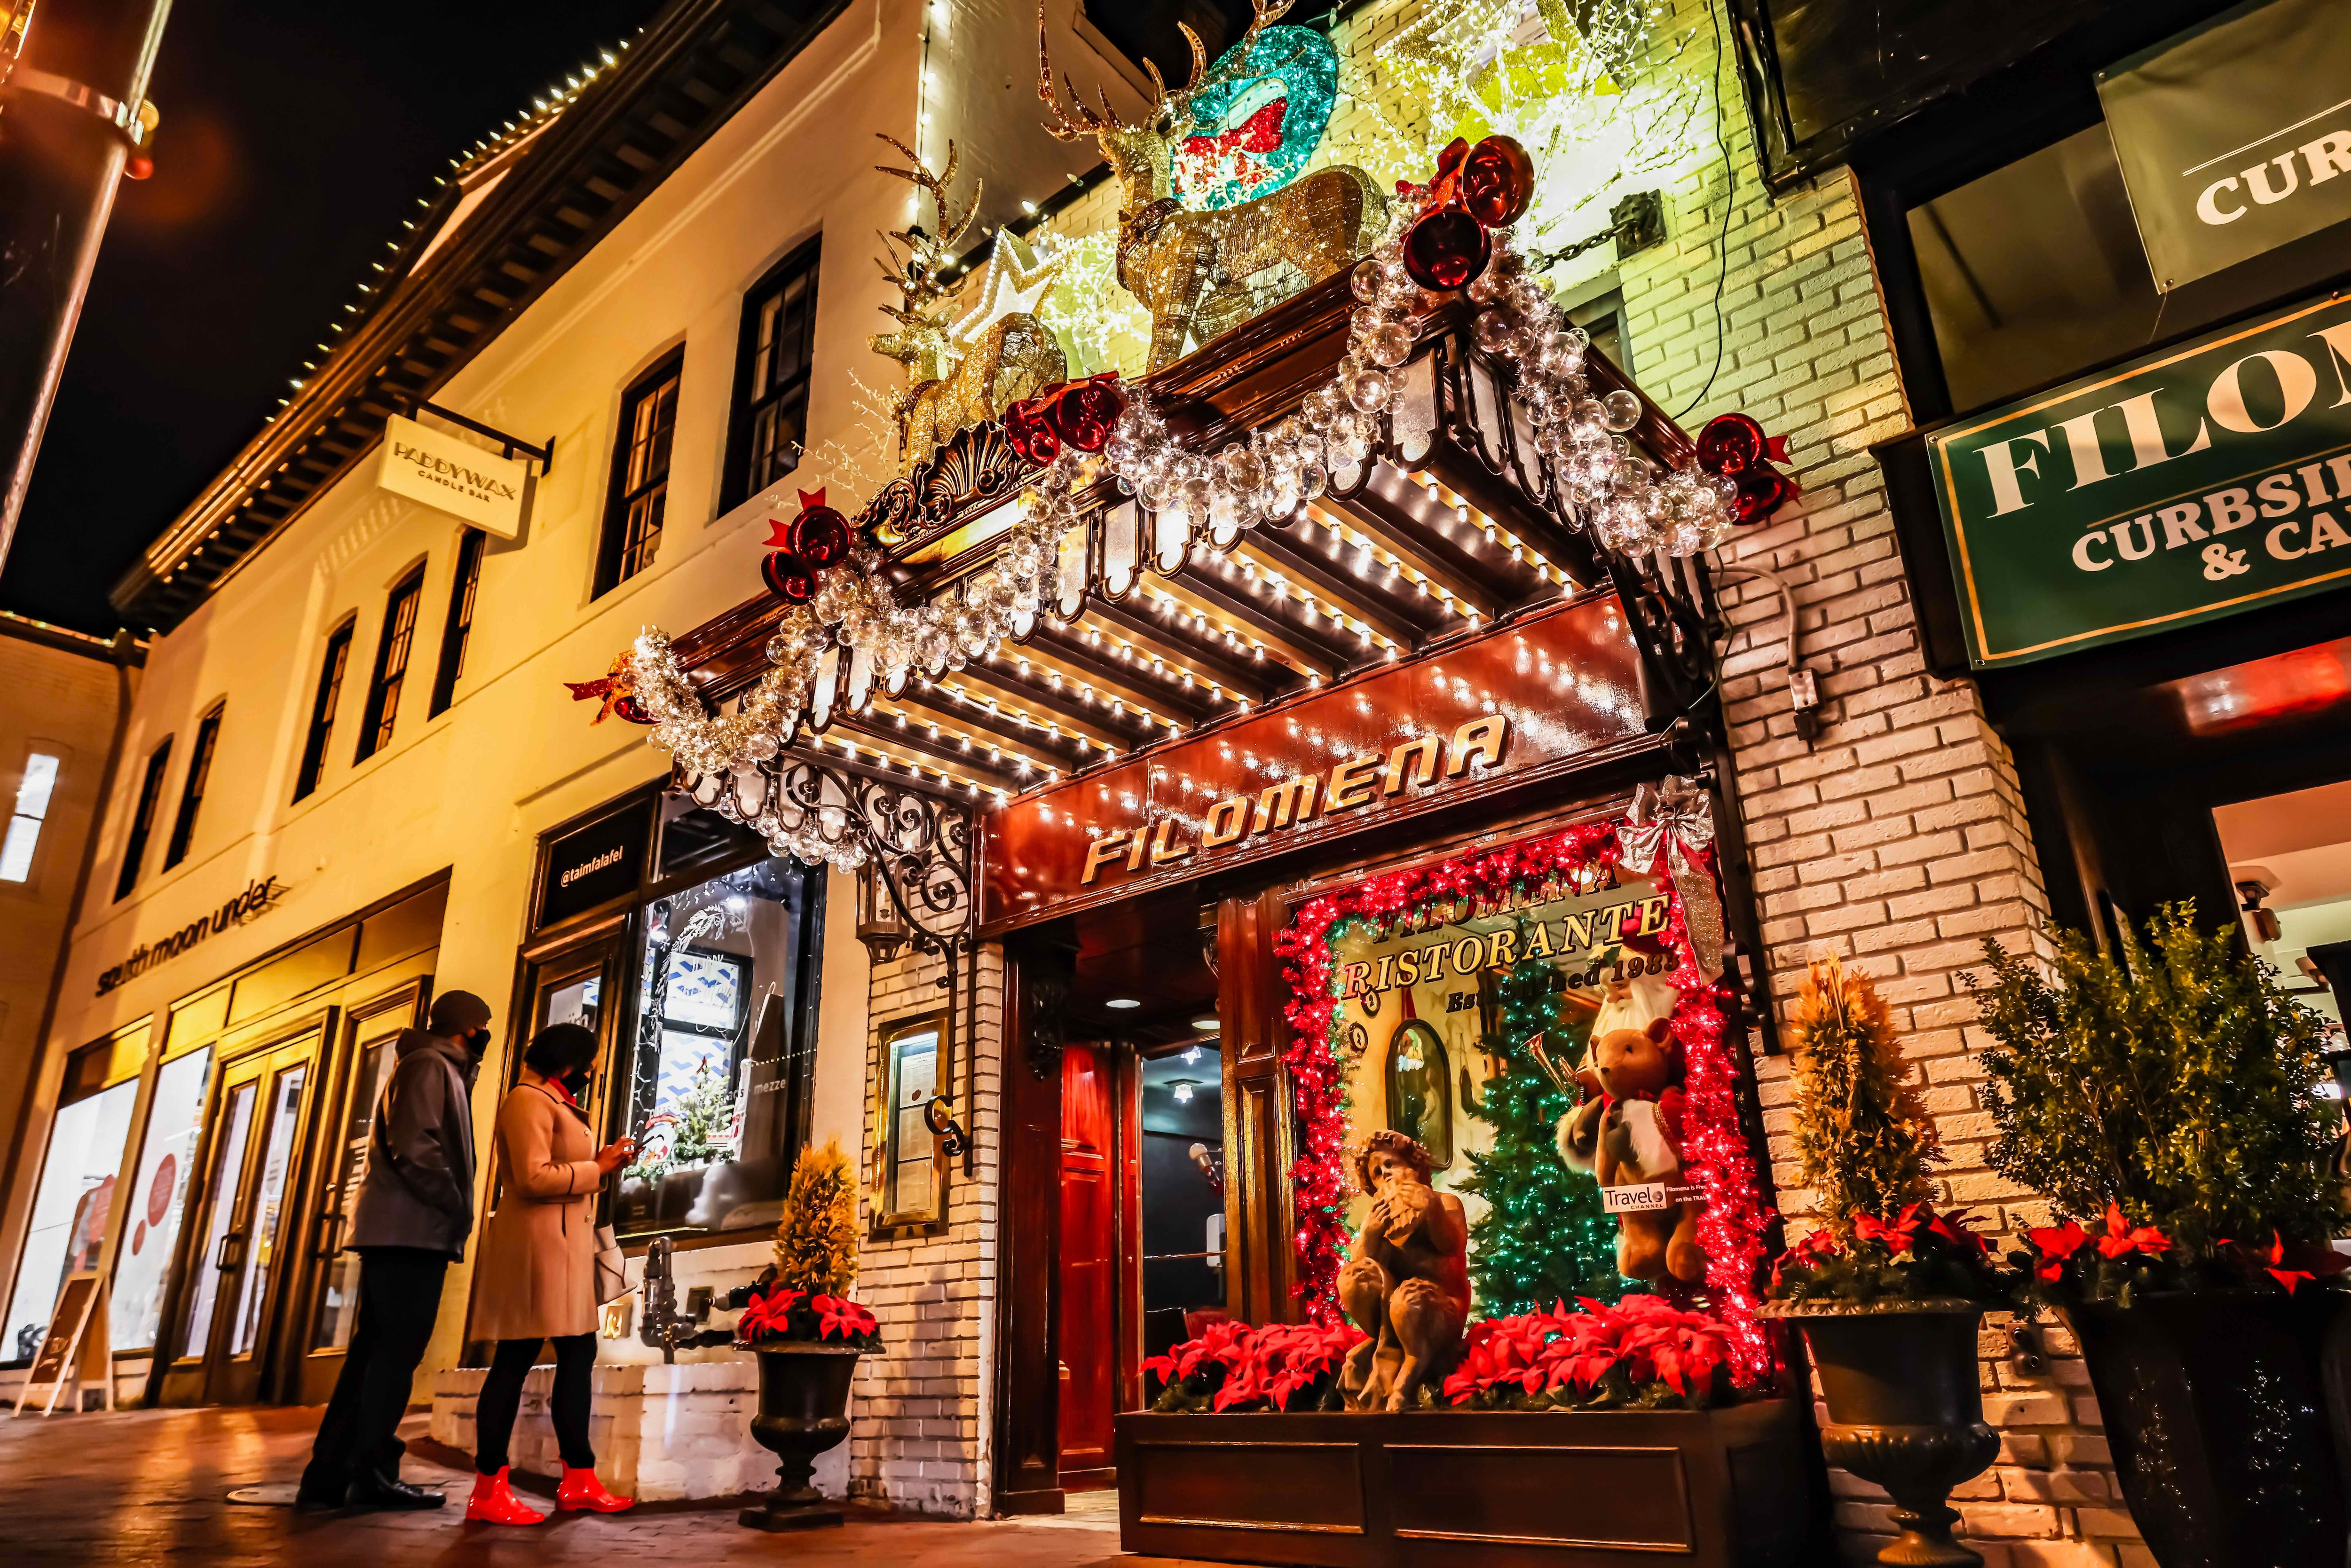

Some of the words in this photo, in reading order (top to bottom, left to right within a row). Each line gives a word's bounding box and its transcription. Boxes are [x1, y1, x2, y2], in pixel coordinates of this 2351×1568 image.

[394, 442, 516, 500] PADDYWAX
[418, 470, 464, 492] CANDLE
[468, 489, 489, 502] BAR
[2201, 543, 2251, 581] &
[2265, 505, 2351, 560] CA
[1081, 714, 1511, 886] FILOMENA
[560, 845, 623, 888] @taimfalafel
[95, 944, 150, 997] south
[149, 916, 210, 966] moon
[212, 875, 277, 934] under
[1341, 893, 1671, 1000] RISTORANTE
[754, 1078, 786, 1095] mezze
[1605, 1187, 1652, 1206] Travel
